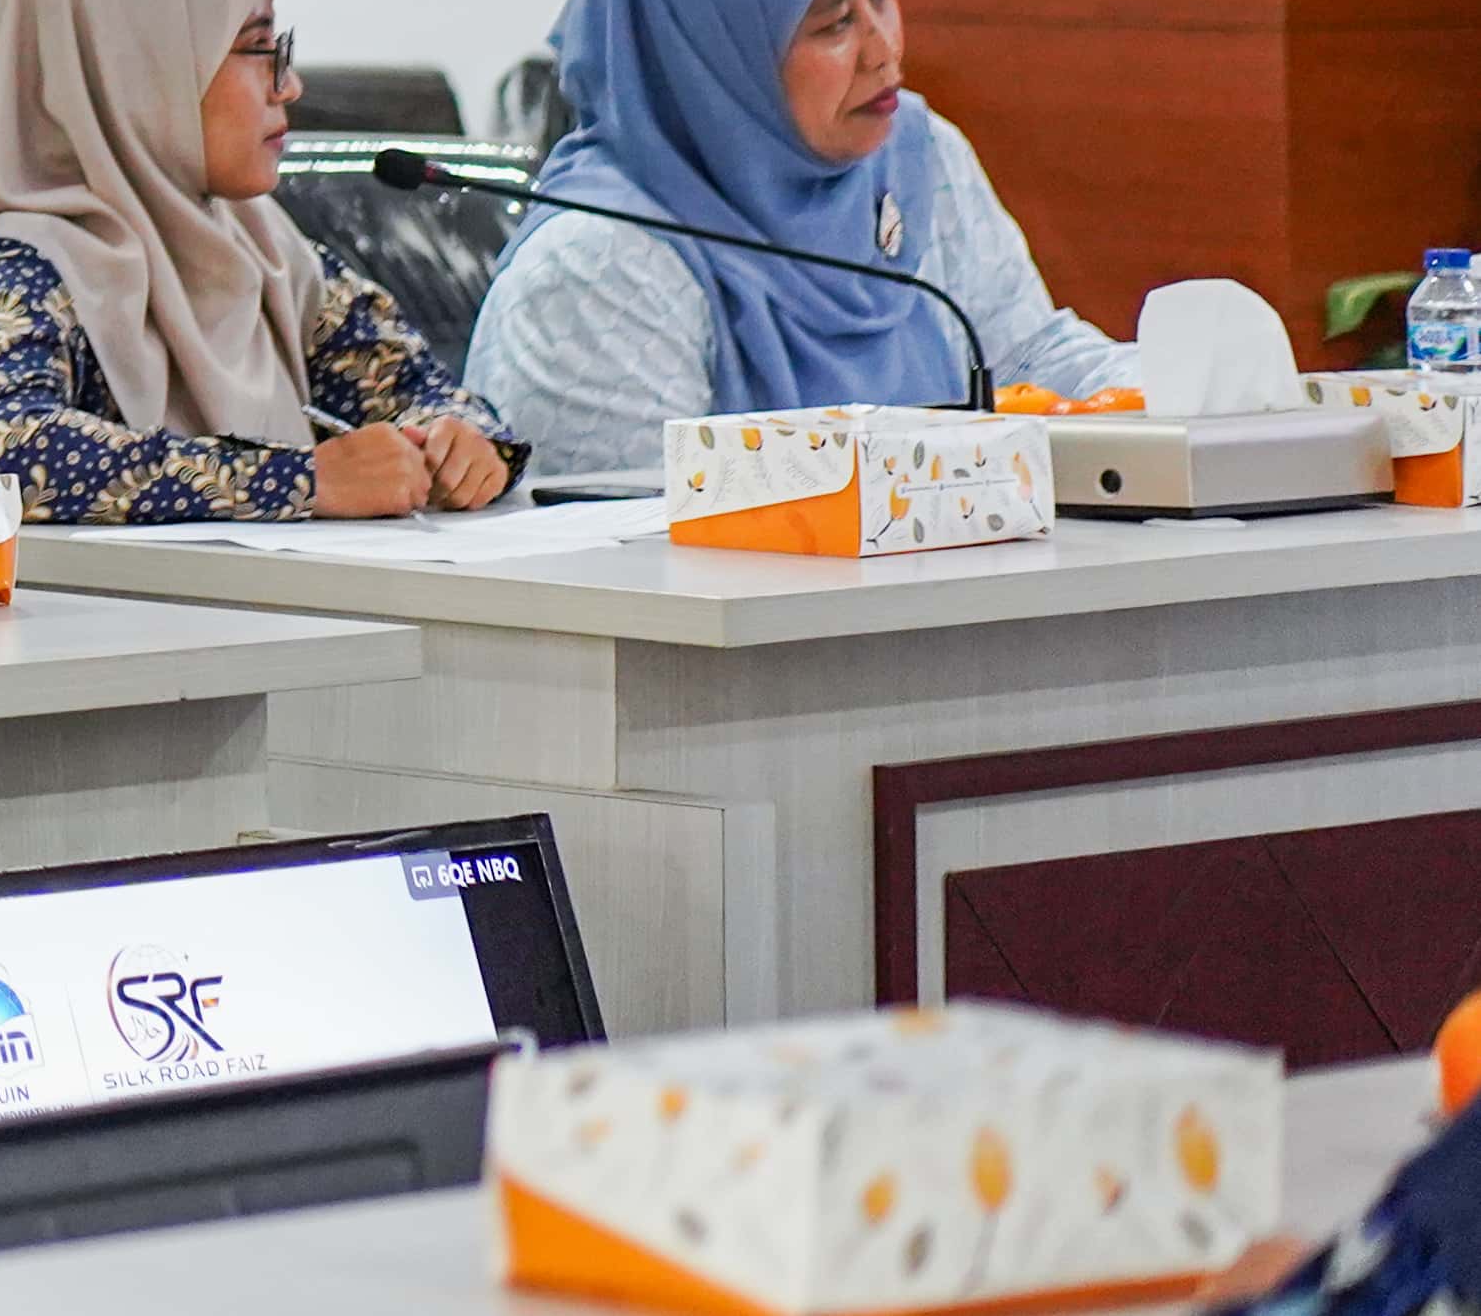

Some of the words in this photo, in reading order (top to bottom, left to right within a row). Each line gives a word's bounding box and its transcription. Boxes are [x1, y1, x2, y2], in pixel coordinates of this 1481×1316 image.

[437, 861, 476, 888] 6QE
[476, 856, 524, 883] NBQ
[117, 971, 225, 1062] SRF
[102, 1068, 154, 1090] SILK
[159, 1060, 221, 1082] ROAD
[226, 1053, 269, 1074] FAIZ
